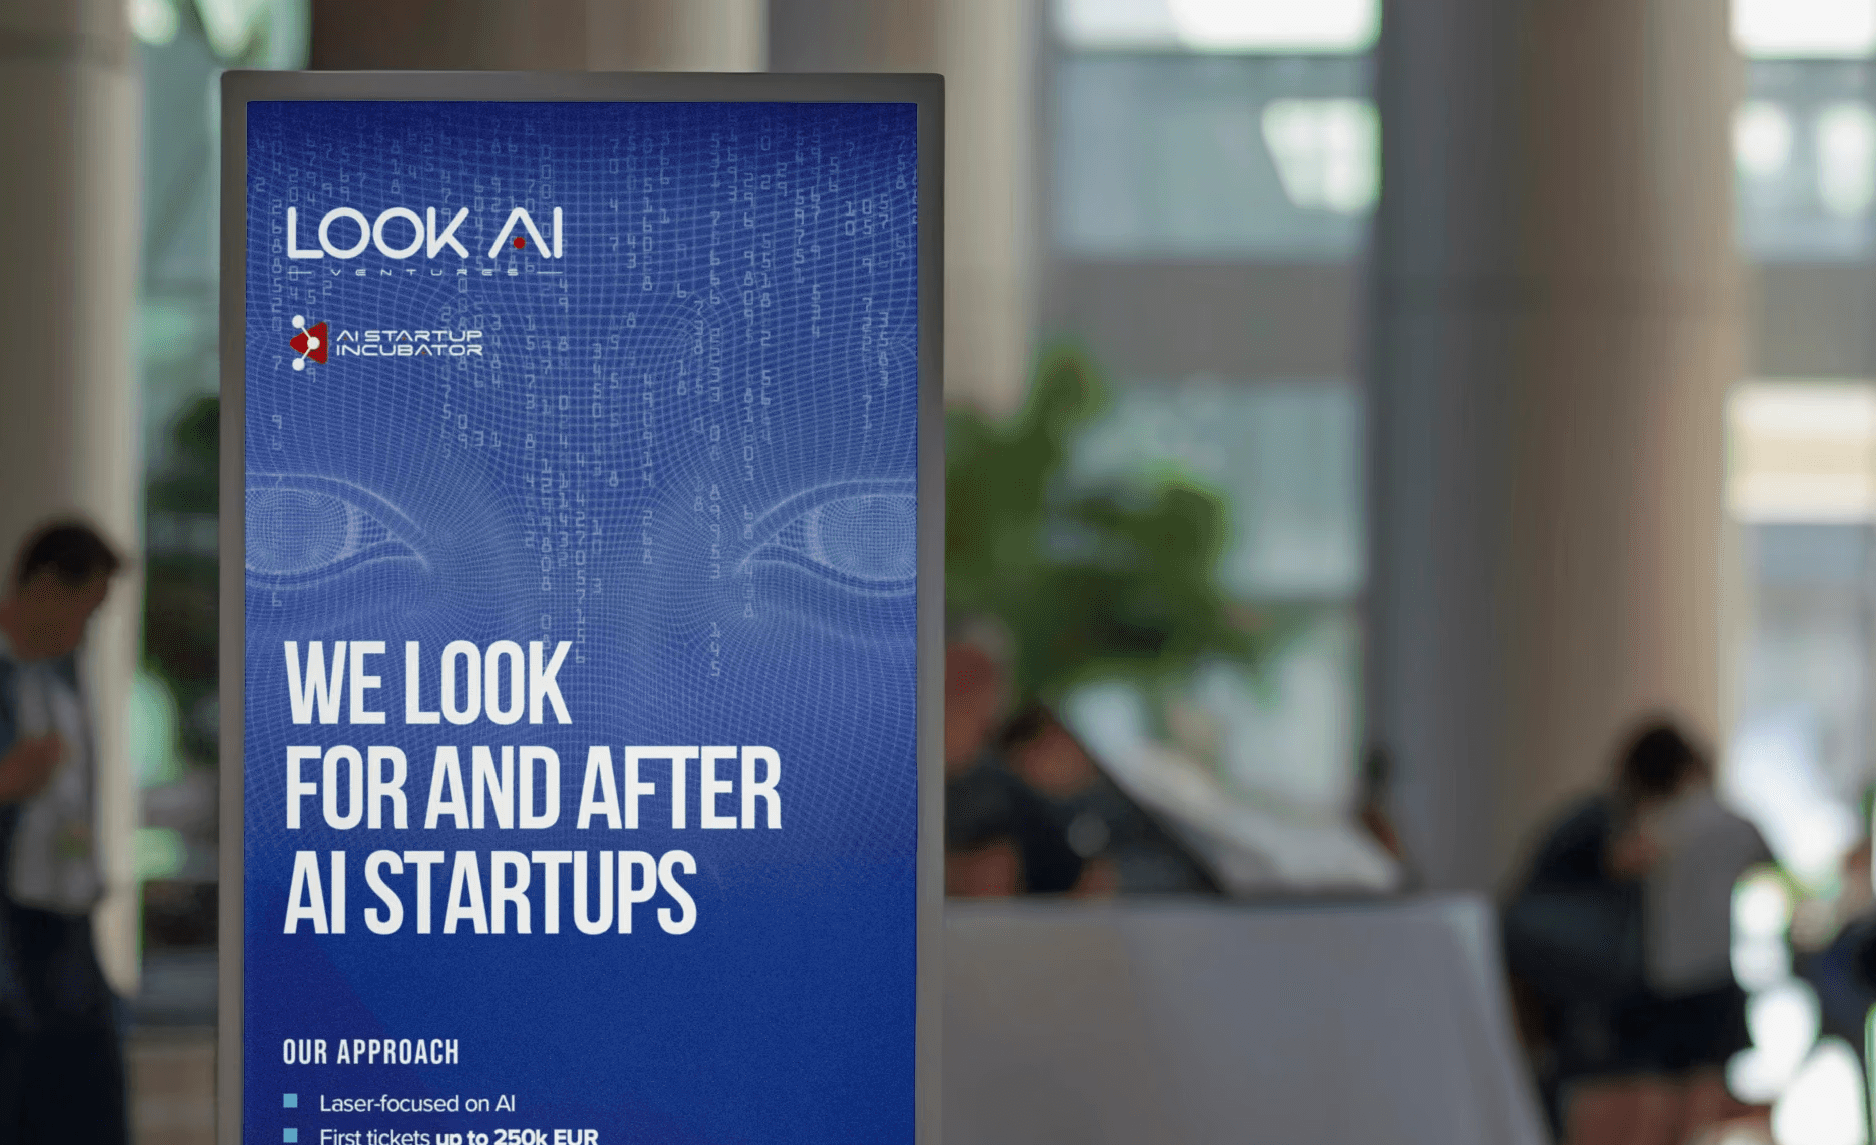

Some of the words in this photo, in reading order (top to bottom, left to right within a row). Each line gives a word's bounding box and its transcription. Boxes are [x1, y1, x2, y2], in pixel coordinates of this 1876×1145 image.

[287, 206, 469, 260] LOOK
[487, 206, 563, 259] AI
[330, 268, 519, 277] VENTURES
[336, 329, 359, 342] AI
[364, 330, 483, 343] STARTUP
[336, 343, 483, 357] INCUBATOR
[283, 640, 386, 725] WE
[405, 639, 573, 726] LOOK
[286, 744, 409, 830] FOR
[423, 745, 561, 830] AND
[576, 745, 782, 830] AFTER
[283, 850, 346, 934] AI
[364, 849, 697, 935] STARTUPS
[283, 1038, 327, 1065] OUR
[336, 1038, 459, 1065] APPROACH
[320, 1094, 459, 1113] Laser-focused
[465, 1098, 490, 1113] on
[494, 1094, 516, 1112] AI
